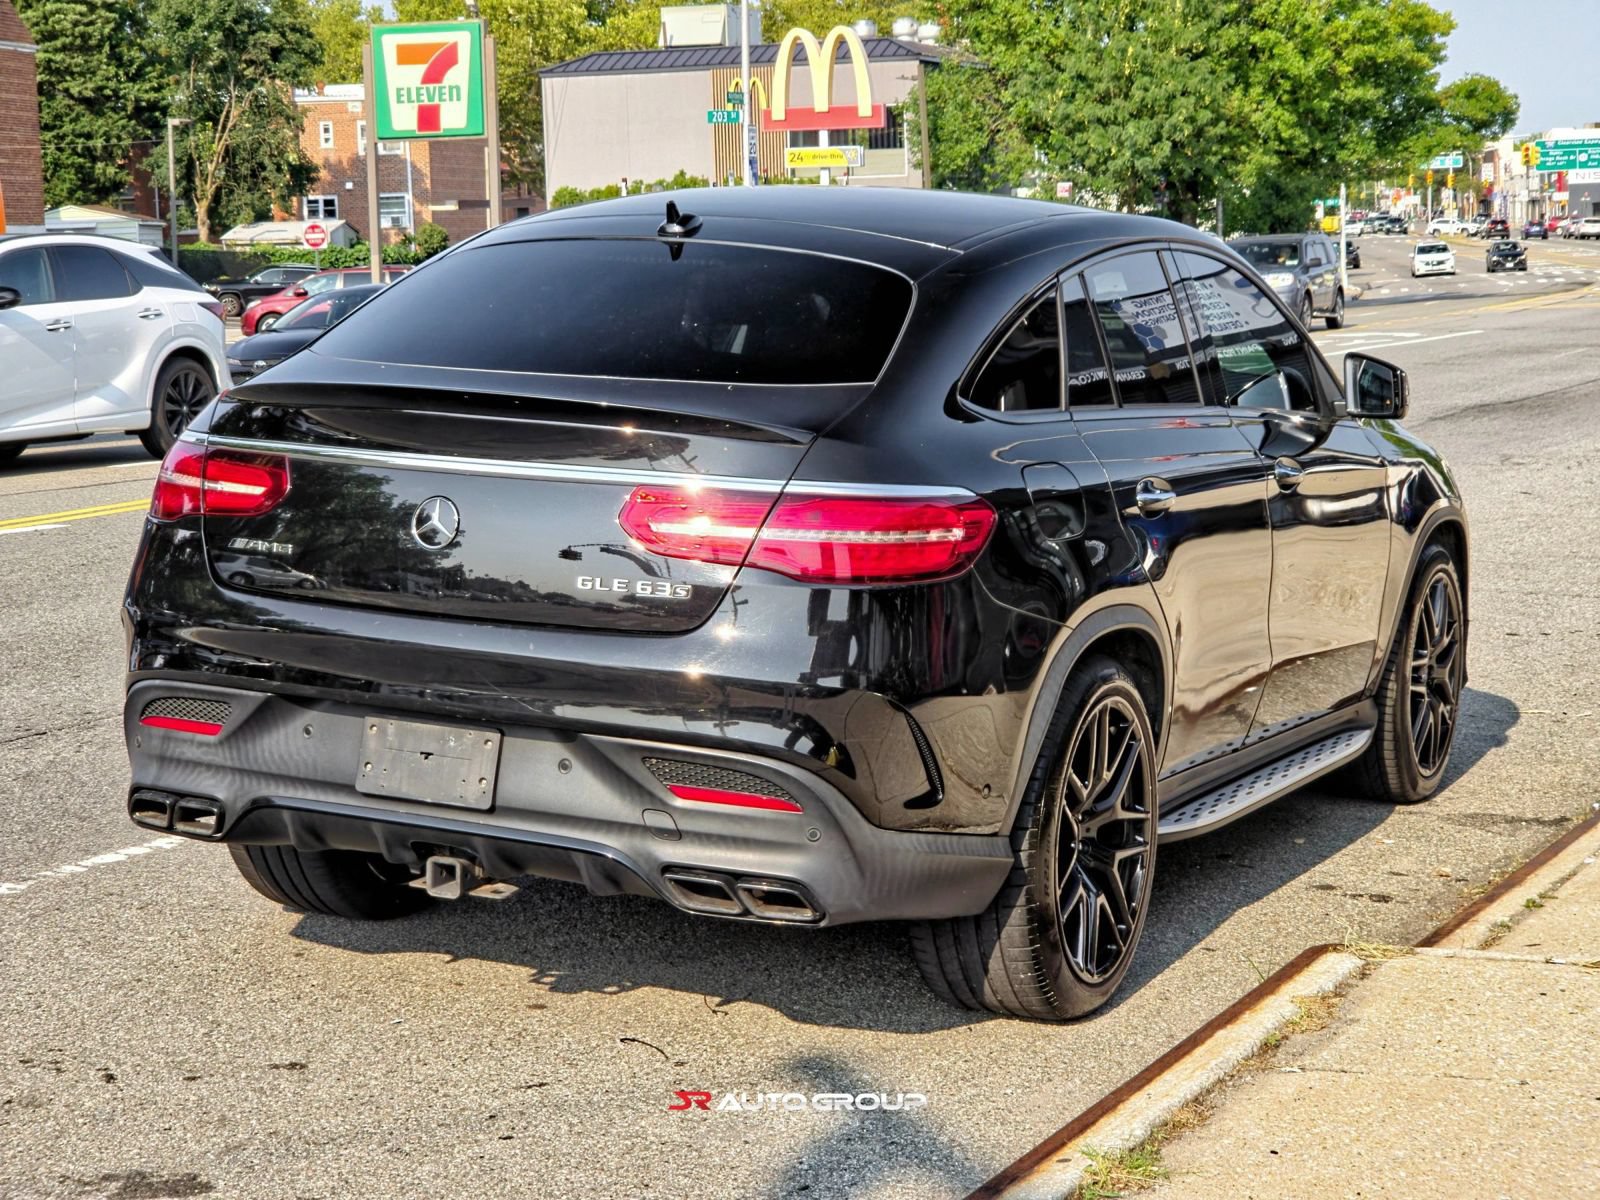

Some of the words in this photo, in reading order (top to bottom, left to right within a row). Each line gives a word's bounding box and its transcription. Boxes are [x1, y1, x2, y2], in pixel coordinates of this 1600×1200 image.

[396, 41, 459, 132] 7
[712, 111, 728, 123] 203
[789, 152, 804, 163] 24
[577, 576, 629, 592] GLE
